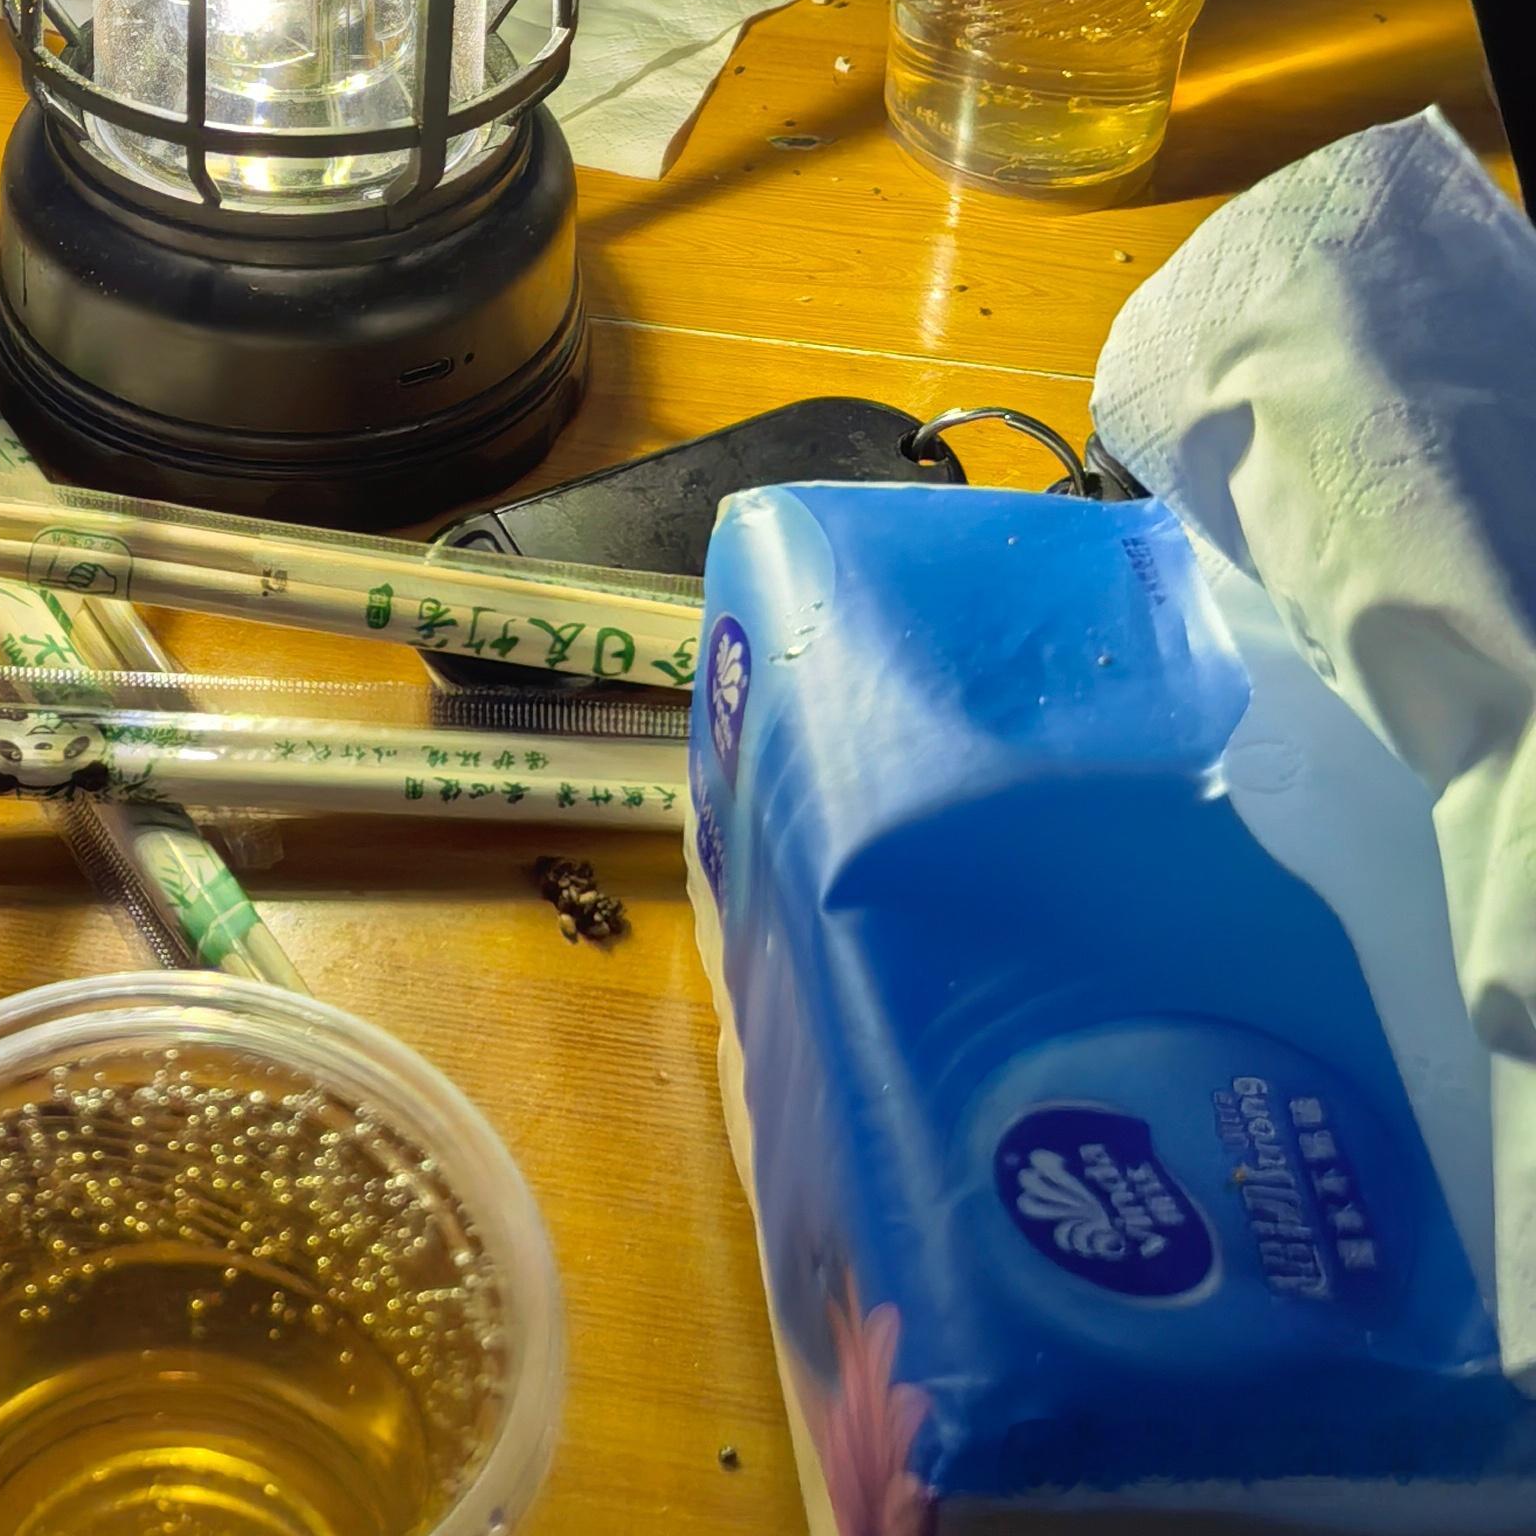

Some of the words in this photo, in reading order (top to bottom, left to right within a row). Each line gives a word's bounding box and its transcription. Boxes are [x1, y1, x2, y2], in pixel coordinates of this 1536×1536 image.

[421, 744, 551, 771] 保护环境
[403, 776, 532, 805] 安心使用
